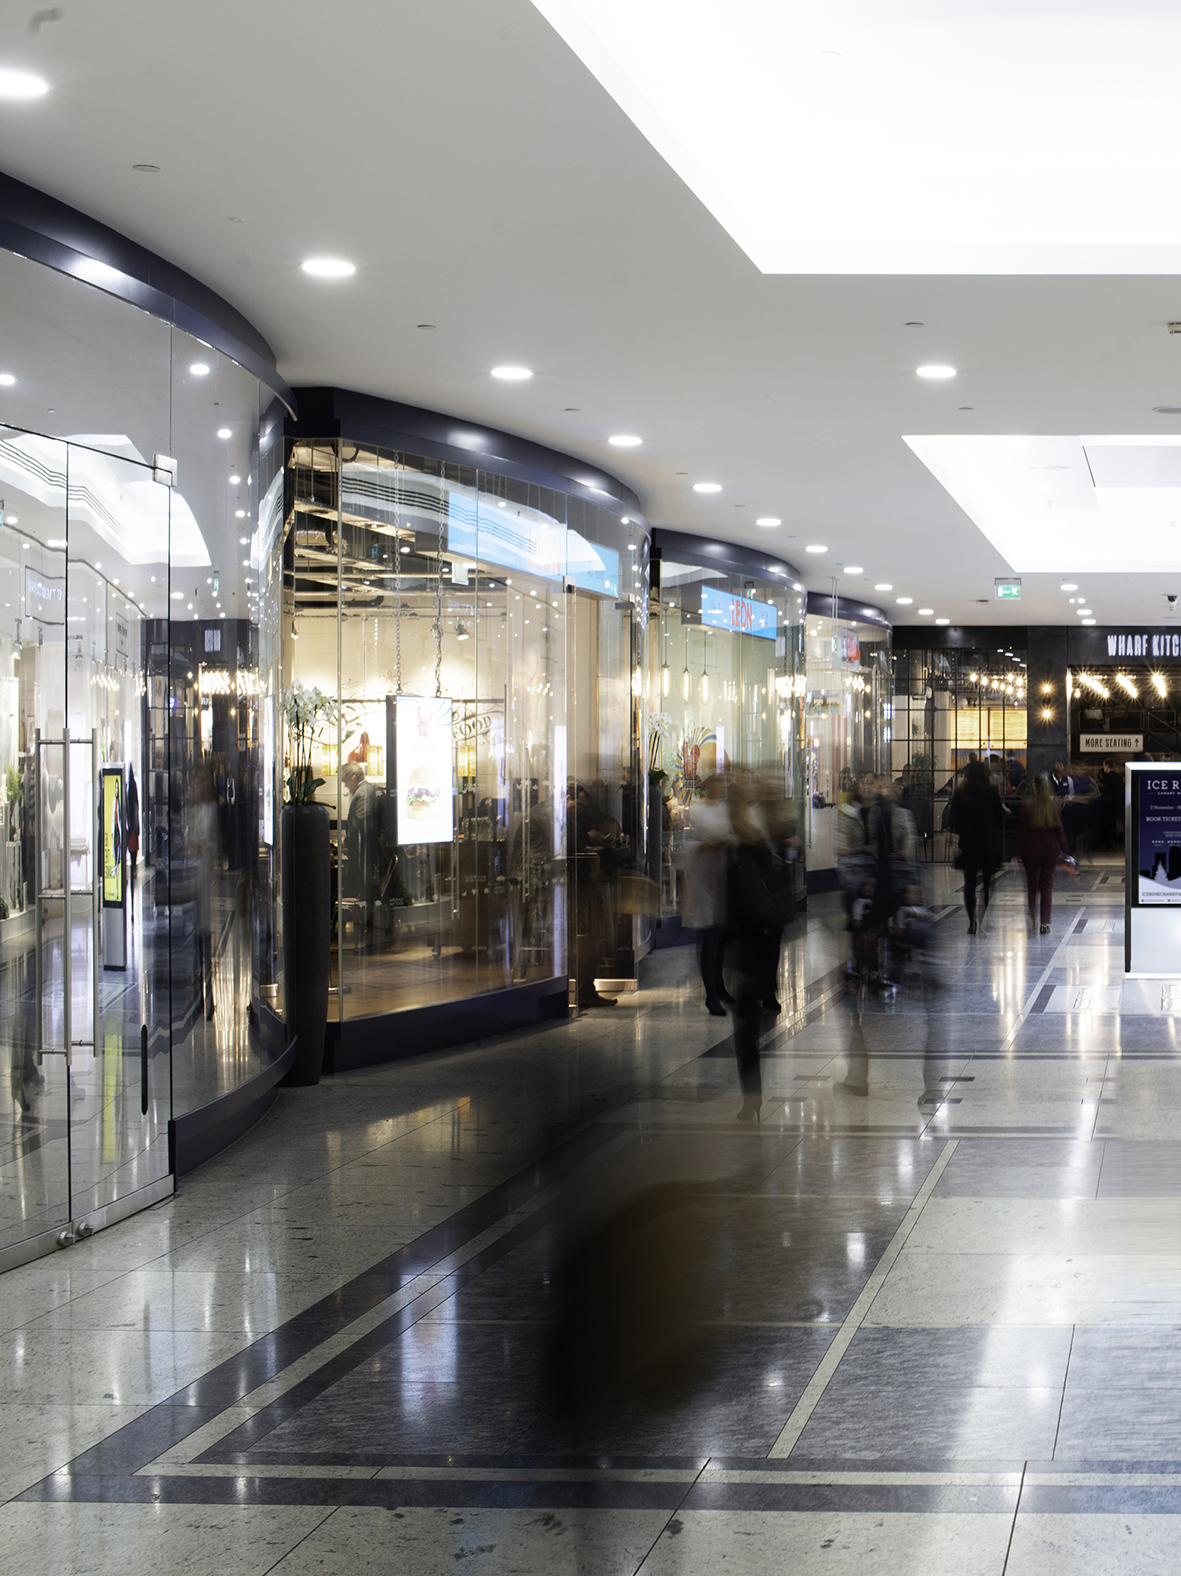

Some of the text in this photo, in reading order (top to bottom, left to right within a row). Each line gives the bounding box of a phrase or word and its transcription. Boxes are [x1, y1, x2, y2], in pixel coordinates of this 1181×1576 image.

[731, 599, 753, 630] LEON
[1107, 634, 1148, 656] WHARF
[1085, 738, 1132, 748] MORE SEATING
[1147, 780, 1168, 790] ICE
